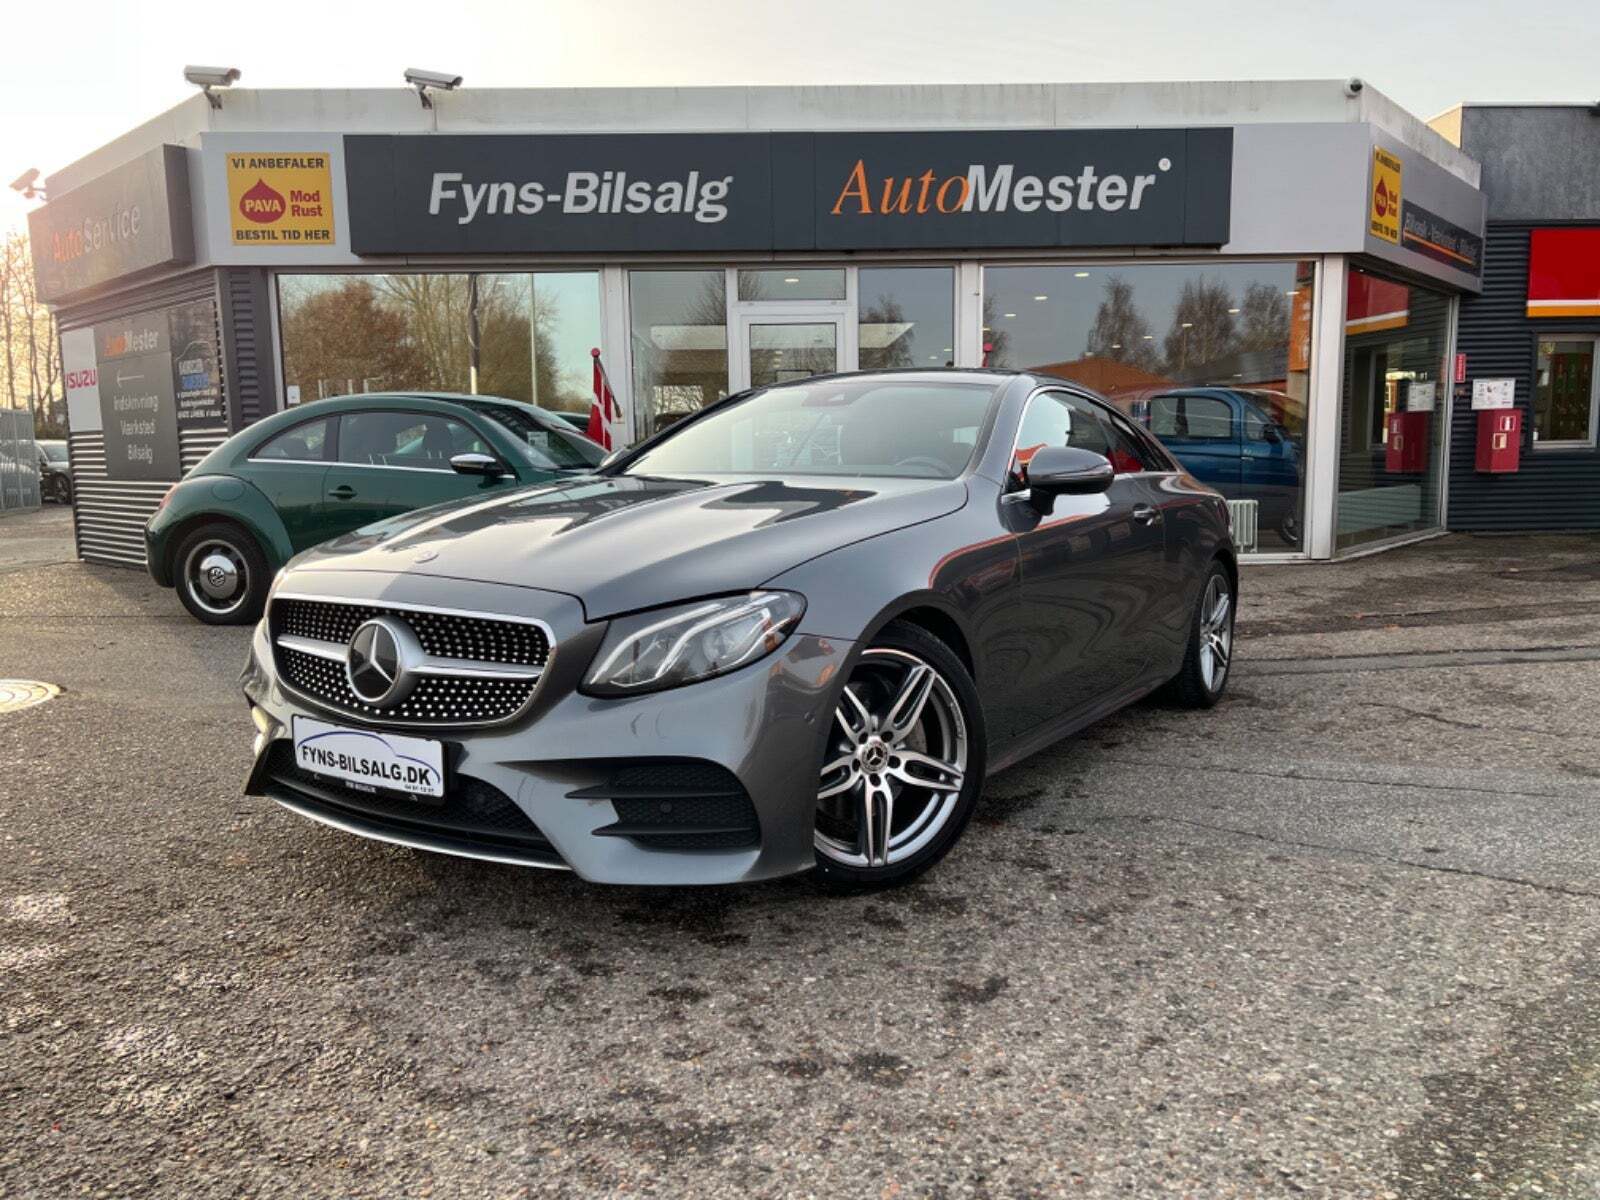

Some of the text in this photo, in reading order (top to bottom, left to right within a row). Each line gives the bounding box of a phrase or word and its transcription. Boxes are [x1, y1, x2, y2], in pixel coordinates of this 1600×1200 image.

[231, 158, 325, 169] VI ANBEFALER
[830, 158, 1156, 215] AutoMester
[289, 190, 321, 202] Mod
[428, 170, 734, 225] Fyns-Bilsalg
[244, 199, 282, 213] PAVA
[290, 204, 323, 217] Rust
[235, 229, 330, 241] BESTIL TID HER
[64, 368, 97, 389] ISUZU
[302, 745, 431, 786] FYNS-BILSALG.DK
